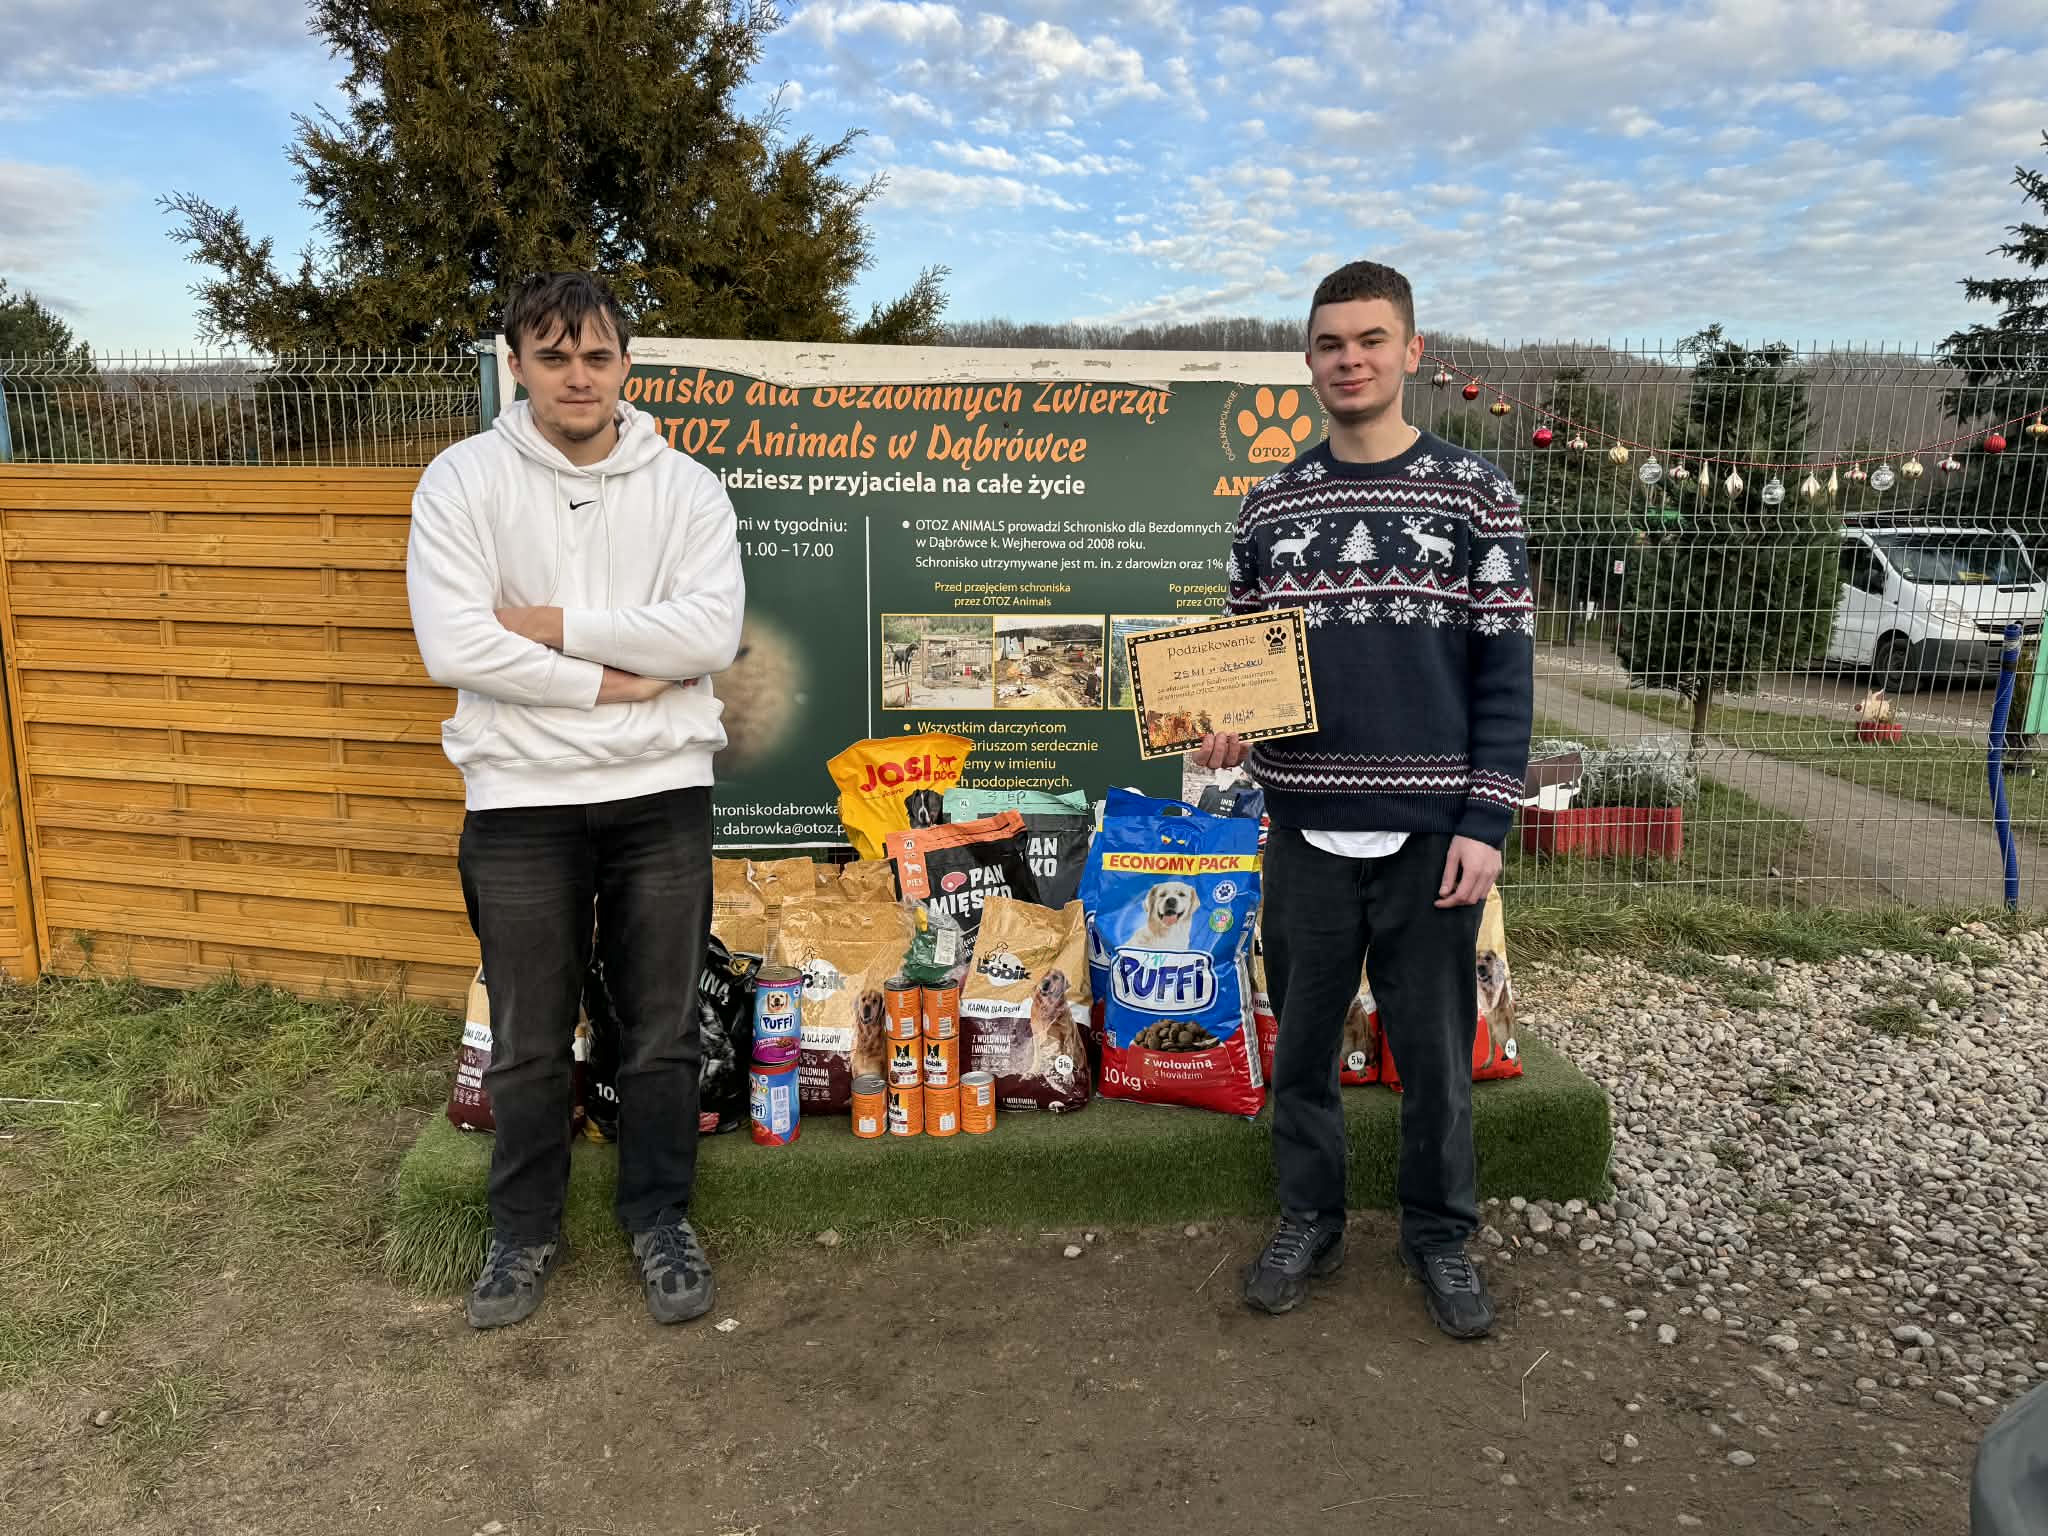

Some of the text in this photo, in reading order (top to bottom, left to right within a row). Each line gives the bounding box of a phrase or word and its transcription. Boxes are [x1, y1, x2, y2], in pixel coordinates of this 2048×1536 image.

[737, 419, 878, 459] Animals
[888, 430, 918, 459] w
[926, 424, 1087, 471] Dąbrówce
[1252, 447, 1291, 458] OTOZ
[808, 470, 936, 496] przyjaciela
[942, 476, 971, 493] na
[976, 473, 1023, 494] całe
[1028, 474, 1087, 499] życie
[736, 517, 848, 536] ni w tygodniu:
[915, 519, 949, 532] OTOZ
[951, 519, 1005, 533] ANIMALS
[1008, 521, 1061, 535] prowadzi
[1063, 521, 1126, 534] Schronisko
[1128, 521, 1146, 533] dla
[1148, 522, 1222, 536] Bezdomnych
[915, 536, 1146, 552] w Dąbrówce k. Wejherowa od 2008 roku.
[915, 556, 978, 569] Schronisko
[981, 558, 1058, 572] utrzymywane
[1060, 557, 1081, 572] jest
[1083, 560, 1098, 569] m.
[1100, 557, 1114, 569] in.
[1116, 559, 1123, 569] z
[1125, 557, 1177, 570] darowizn
[1179, 559, 1203, 570] oraz
[1206, 558, 1224, 570] 1%
[934, 581, 1072, 595] Przed przejęciem schroniska
[1169, 583, 1227, 596] Po przejęciu
[954, 596, 1052, 608] przez OTOZ Animals
[1176, 599, 1202, 609] przez
[1168, 634, 1257, 660] Podziękowanie
[917, 720, 1067, 738] Wszystkim darczyńcom
[1031, 739, 1099, 752] serdecznie
[994, 759, 1005, 769] w
[1008, 757, 1056, 769] imieniu
[860, 755, 931, 792] JOSI
[957, 775, 1073, 790] h podopiecznych.
[1110, 855, 1240, 872] ECONOMY PACK
[968, 864, 1005, 887] PAN
[967, 1003, 989, 1013] KARMA
[991, 1004, 1002, 1014] DLA
[1105, 1066, 1142, 1092] 10 kg
